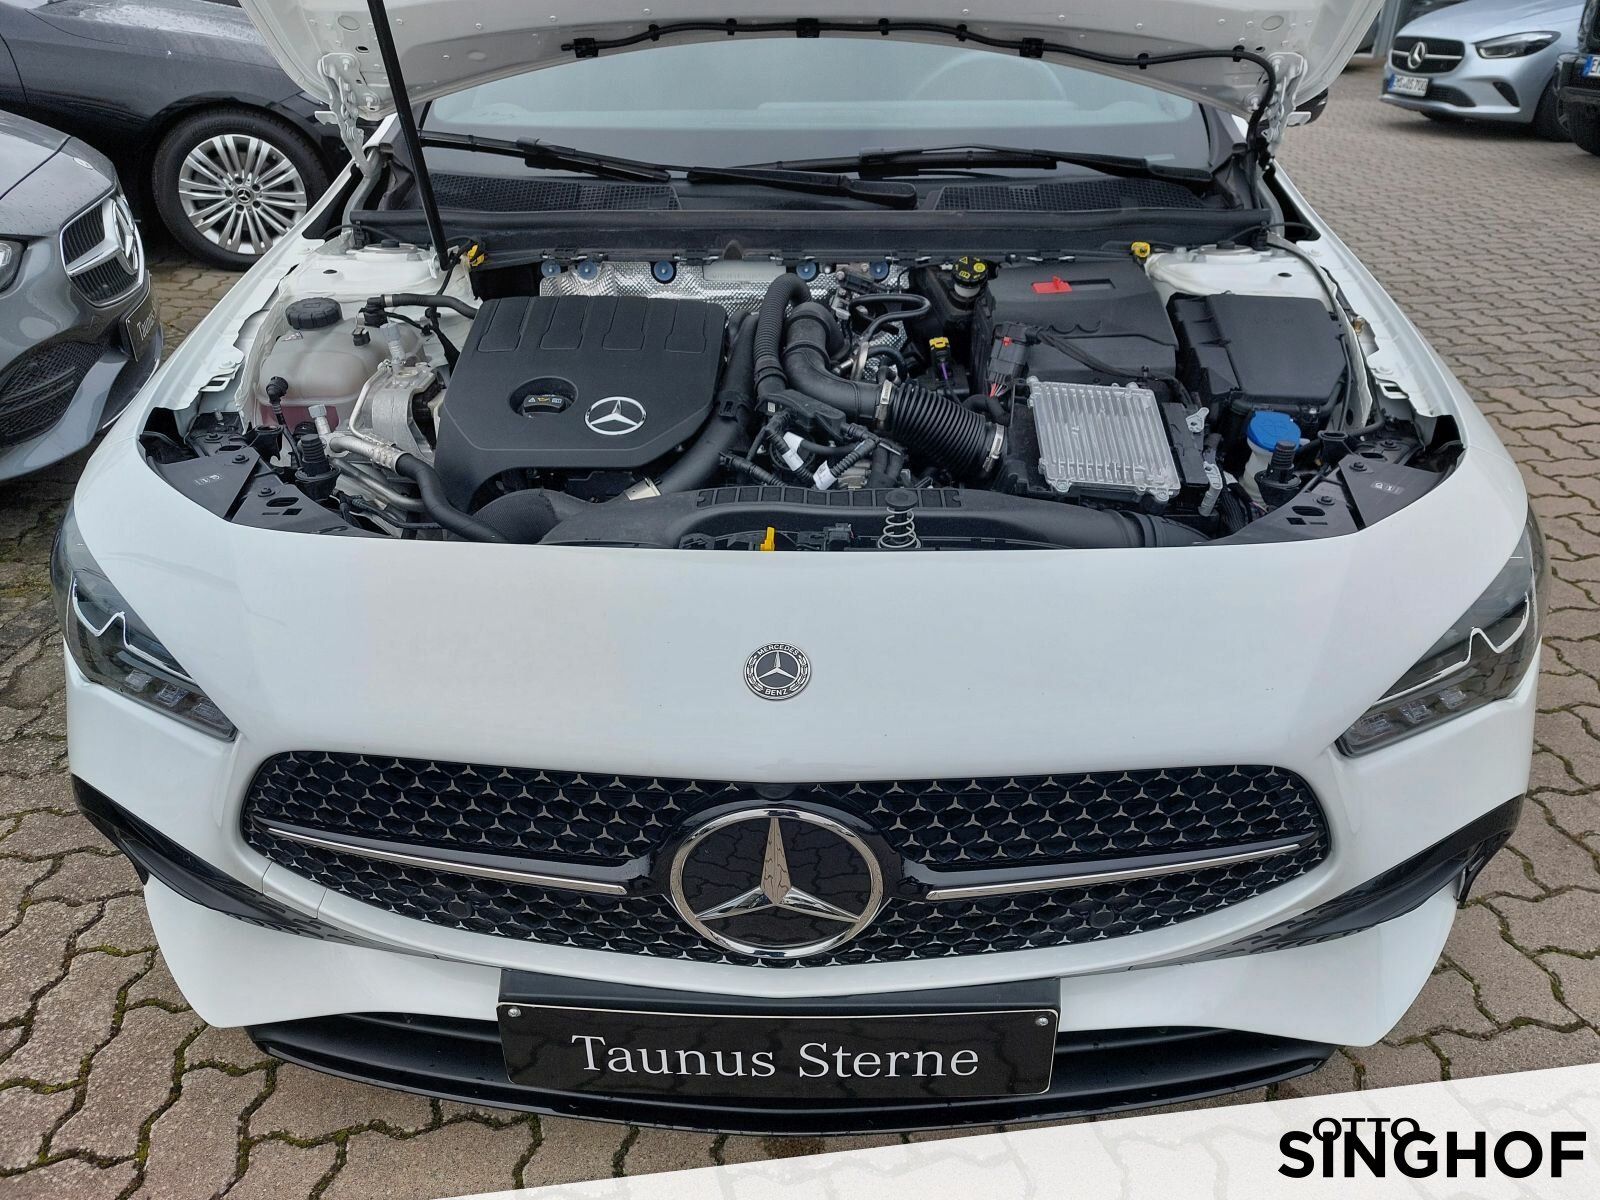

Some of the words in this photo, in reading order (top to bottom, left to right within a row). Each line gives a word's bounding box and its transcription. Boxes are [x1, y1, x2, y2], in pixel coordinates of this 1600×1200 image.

[757, 644, 799, 656] MERCEDES
[764, 688, 788, 696] BENZ
[571, 1034, 776, 1077] Taunus
[799, 1042, 979, 1078] Sterne
